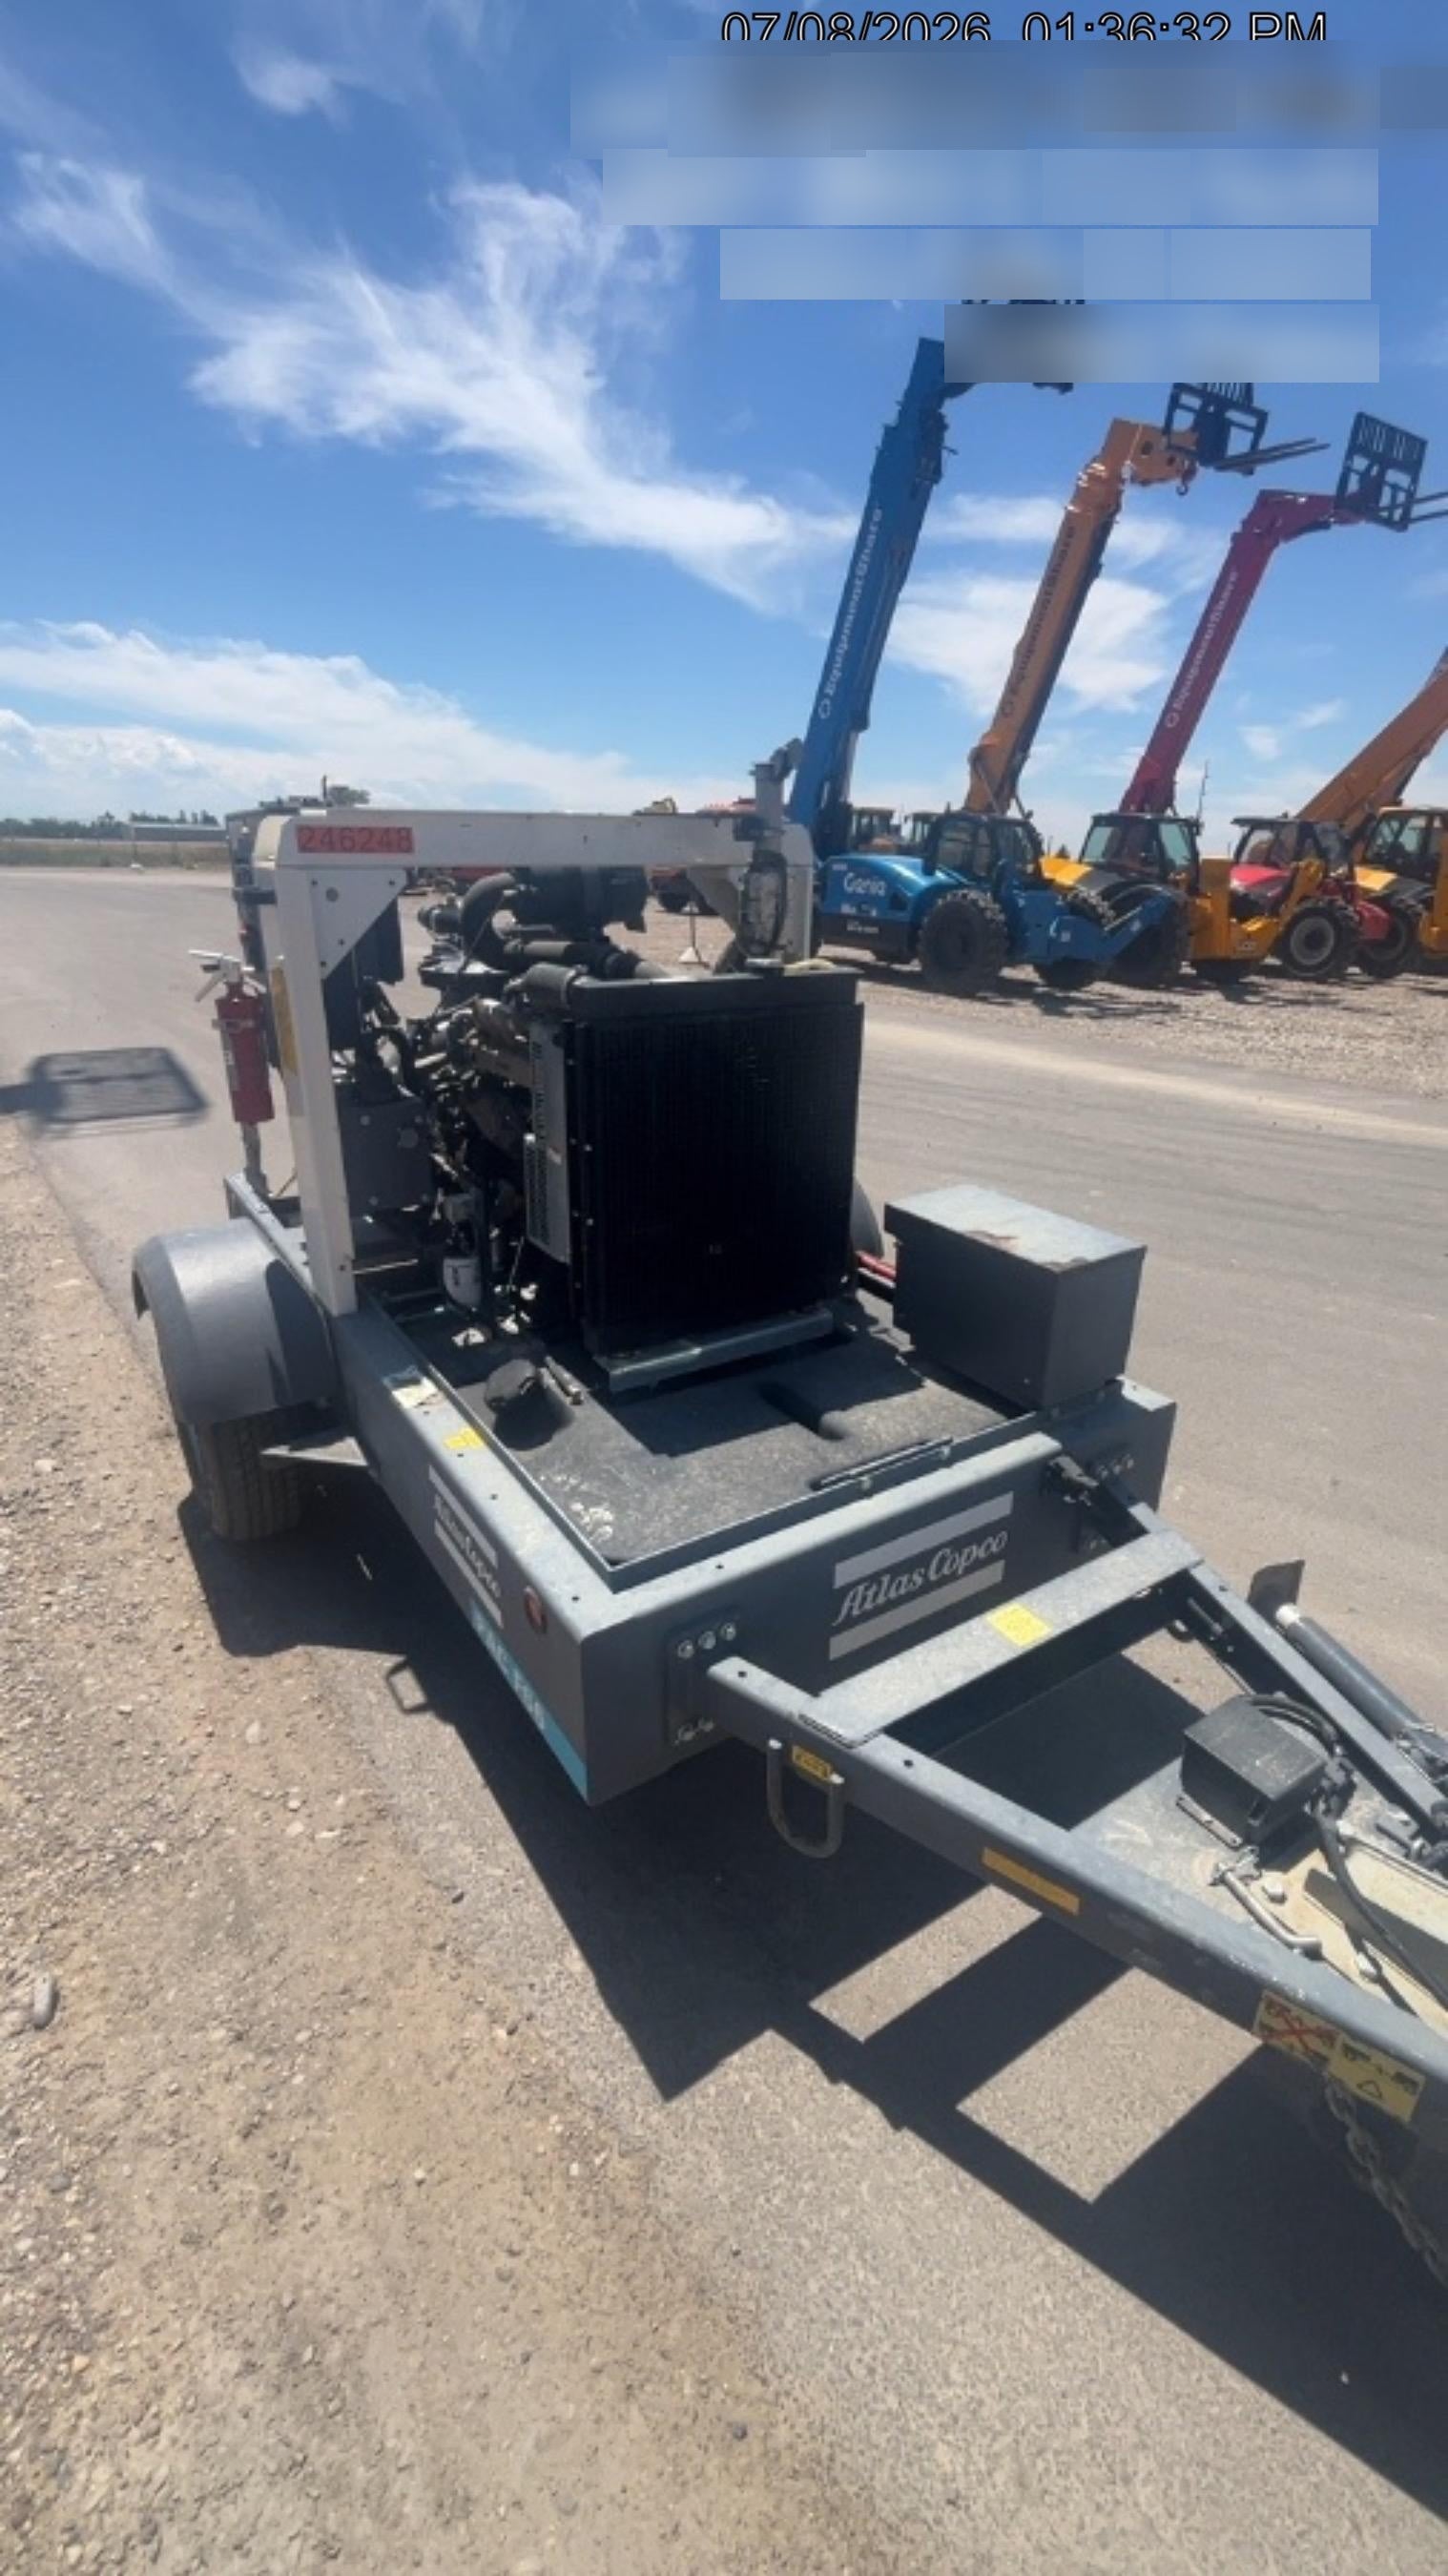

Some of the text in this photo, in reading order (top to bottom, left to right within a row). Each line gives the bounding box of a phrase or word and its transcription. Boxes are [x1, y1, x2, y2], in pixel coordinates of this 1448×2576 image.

[298, 826, 413, 853] 246248
[832, 1530, 1008, 1626] Atlas Copco
